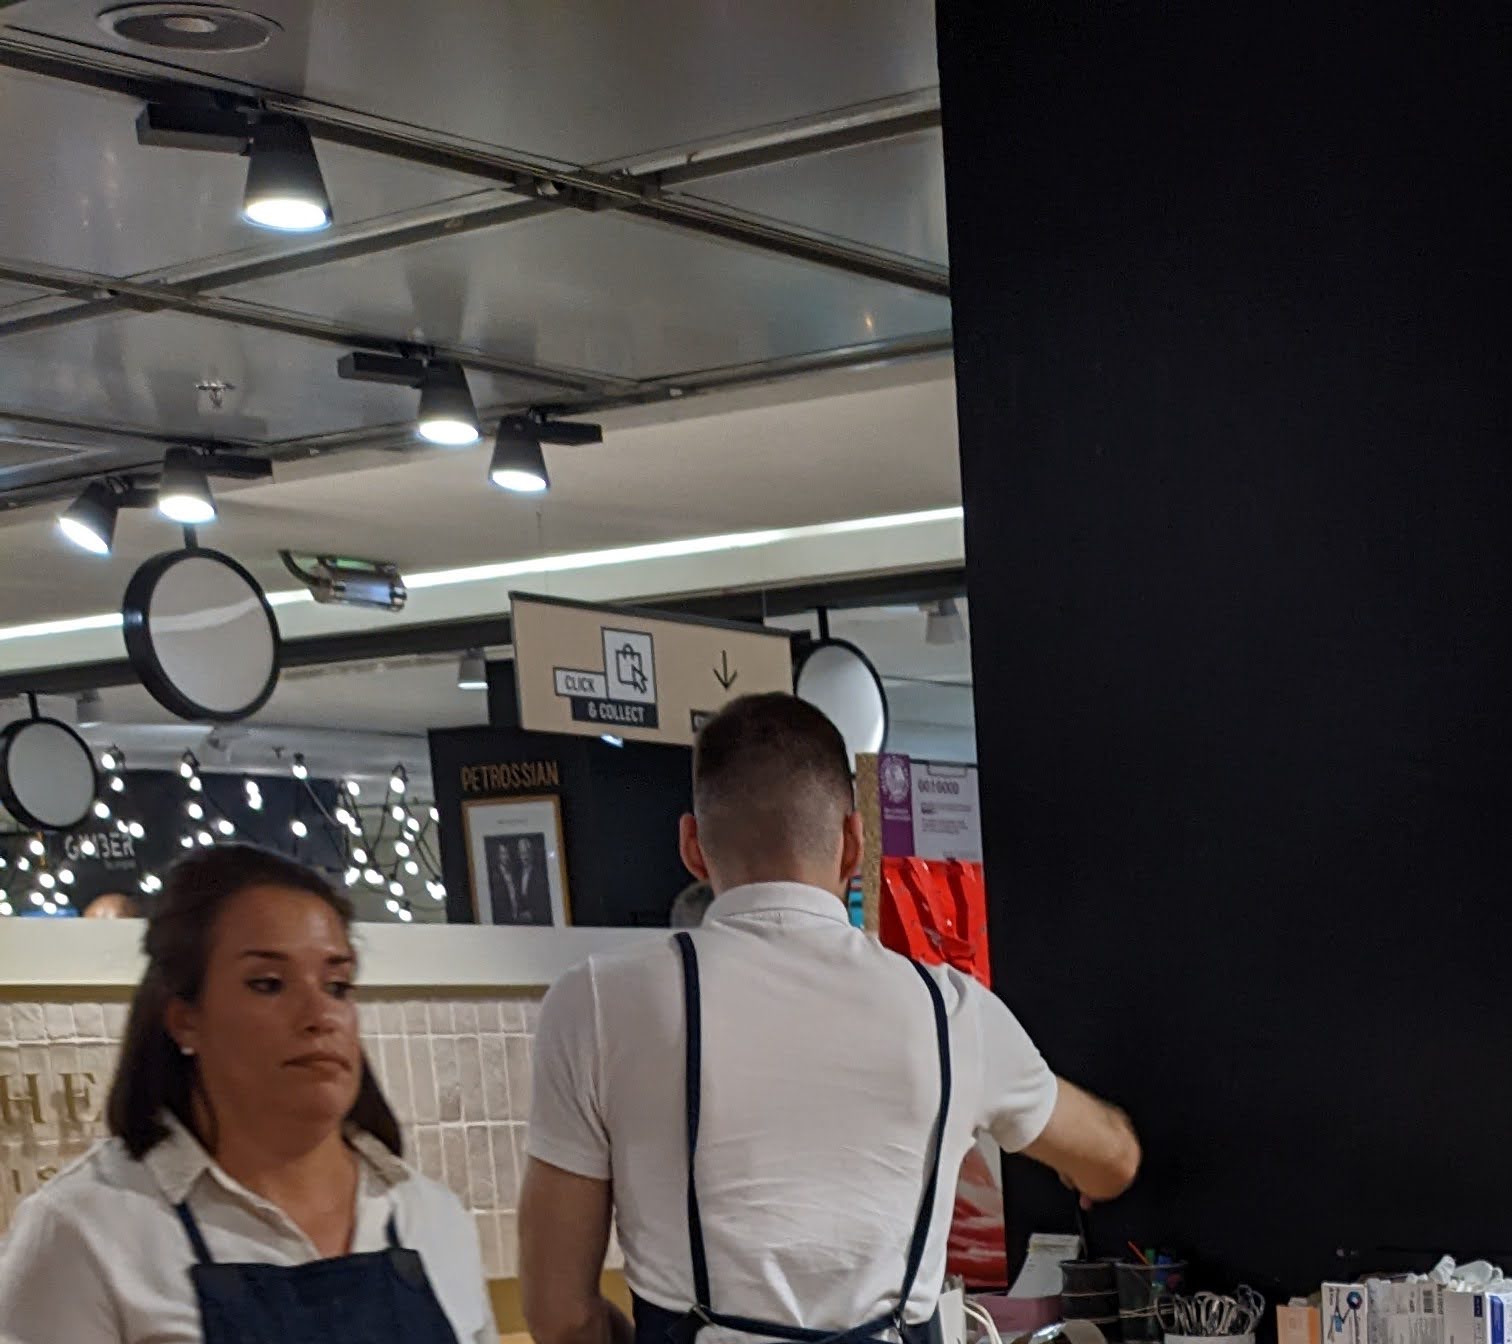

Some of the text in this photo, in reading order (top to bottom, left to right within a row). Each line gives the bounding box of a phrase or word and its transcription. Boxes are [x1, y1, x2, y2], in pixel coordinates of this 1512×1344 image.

[565, 674, 596, 693] CLICK
[600, 702, 645, 723] COLLECT
[461, 760, 559, 791] PETROSSIAN
